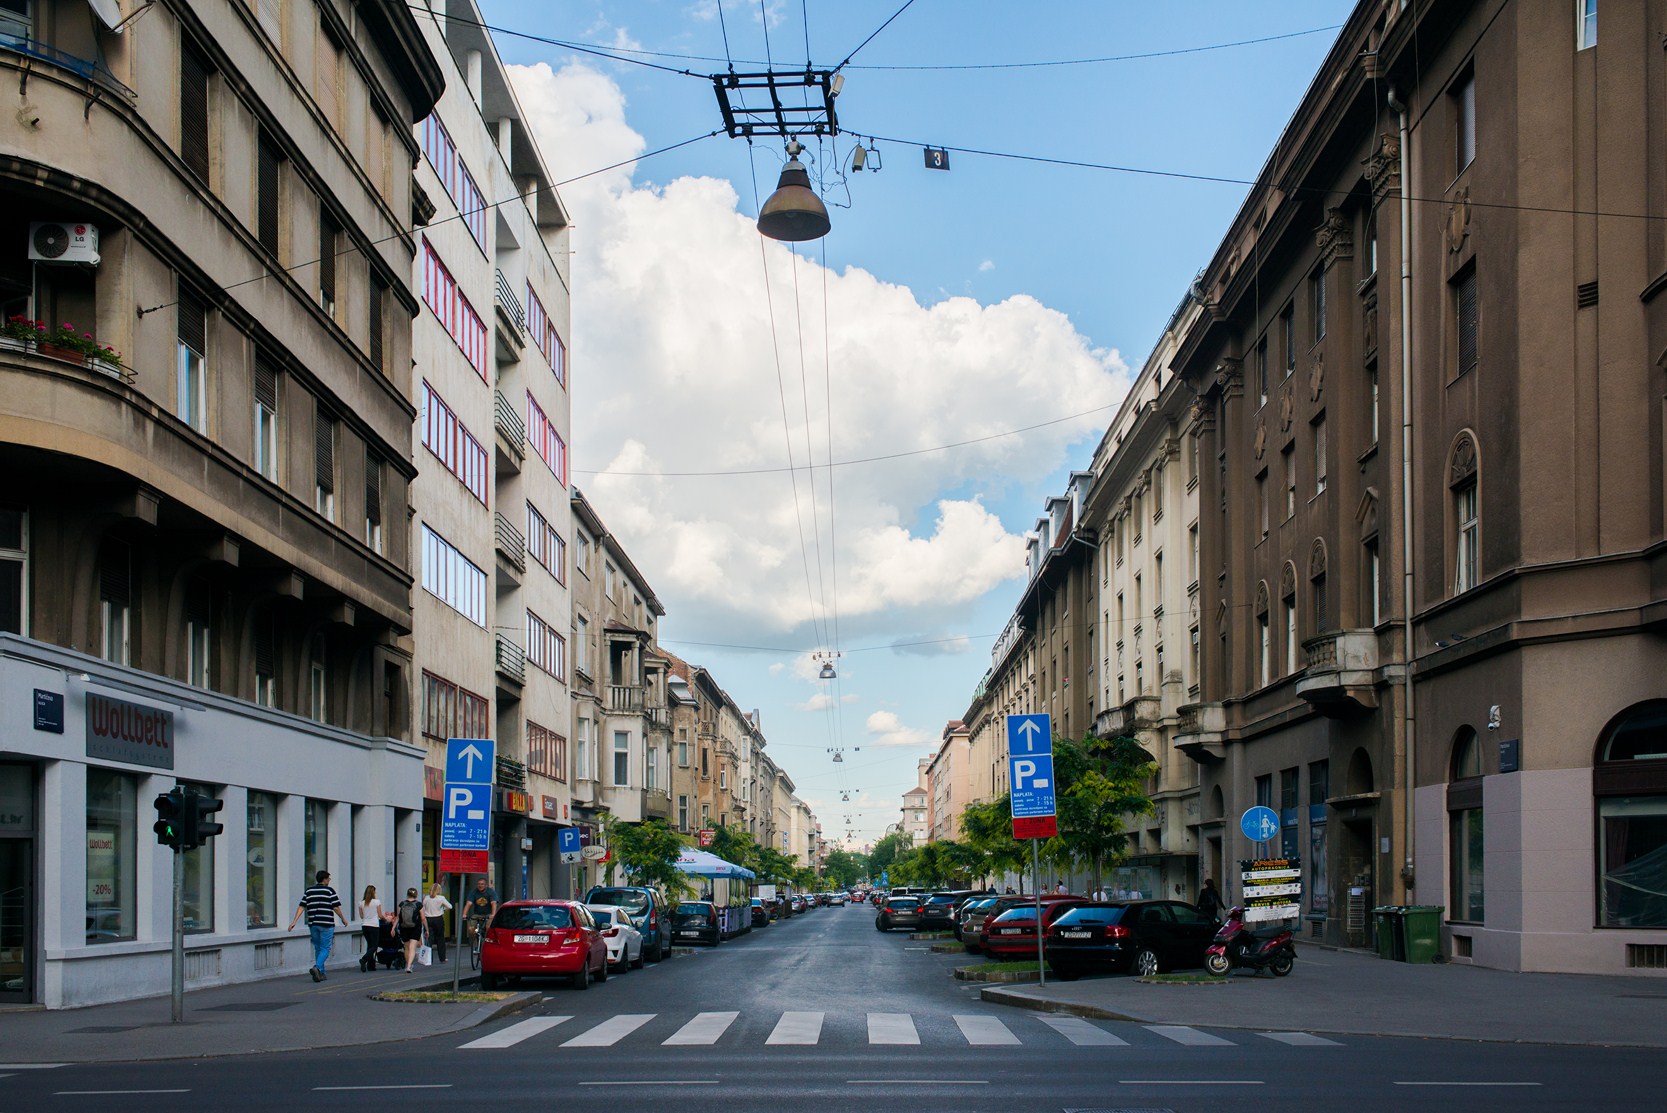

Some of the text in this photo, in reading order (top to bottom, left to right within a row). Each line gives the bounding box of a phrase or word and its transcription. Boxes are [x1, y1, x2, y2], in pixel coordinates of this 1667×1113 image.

[934, 152, 941, 166] 3
[92, 696, 169, 749] Wollbett
[1014, 760, 1036, 789] P
[448, 787, 473, 819] P
[564, 833, 574, 847] P
[92, 884, 112, 895] -20%
